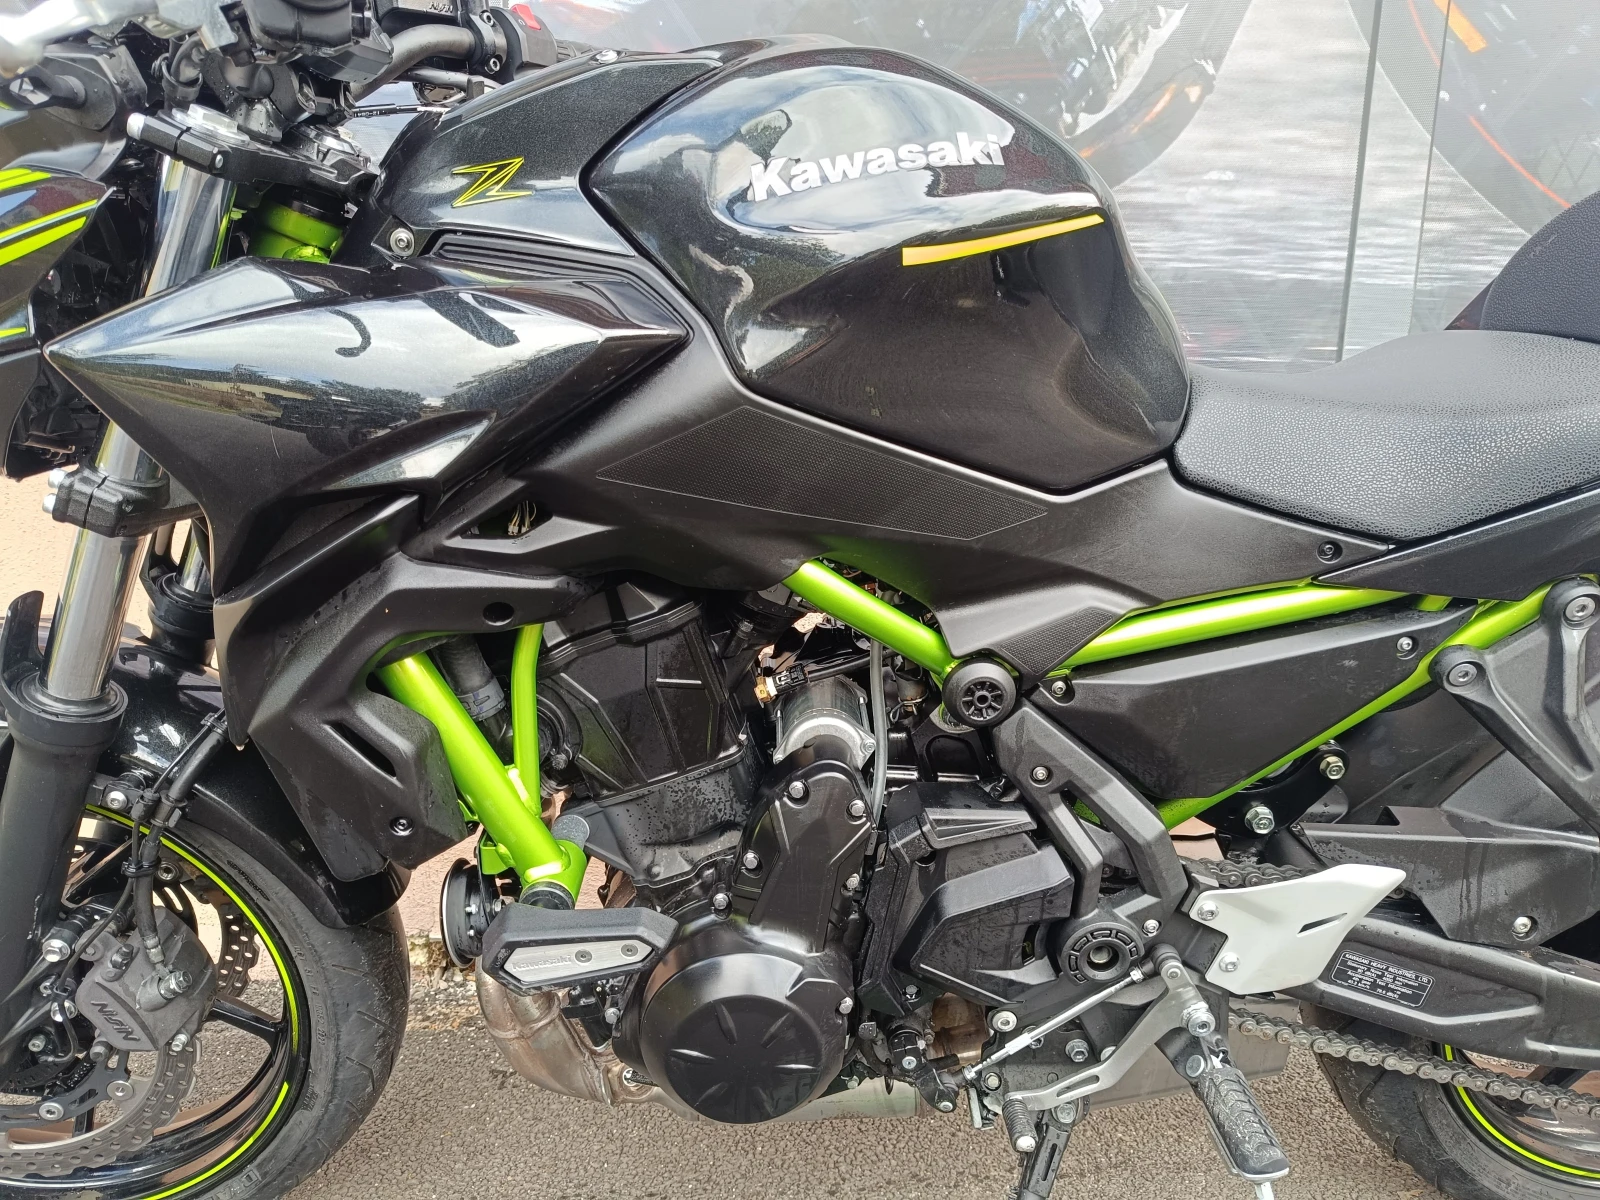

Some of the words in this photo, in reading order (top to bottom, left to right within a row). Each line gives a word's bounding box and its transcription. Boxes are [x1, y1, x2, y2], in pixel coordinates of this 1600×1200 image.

[451, 156, 535, 208] Z
[750, 132, 1005, 201] Kawasaki
[511, 955, 572, 972] Kawasaki
